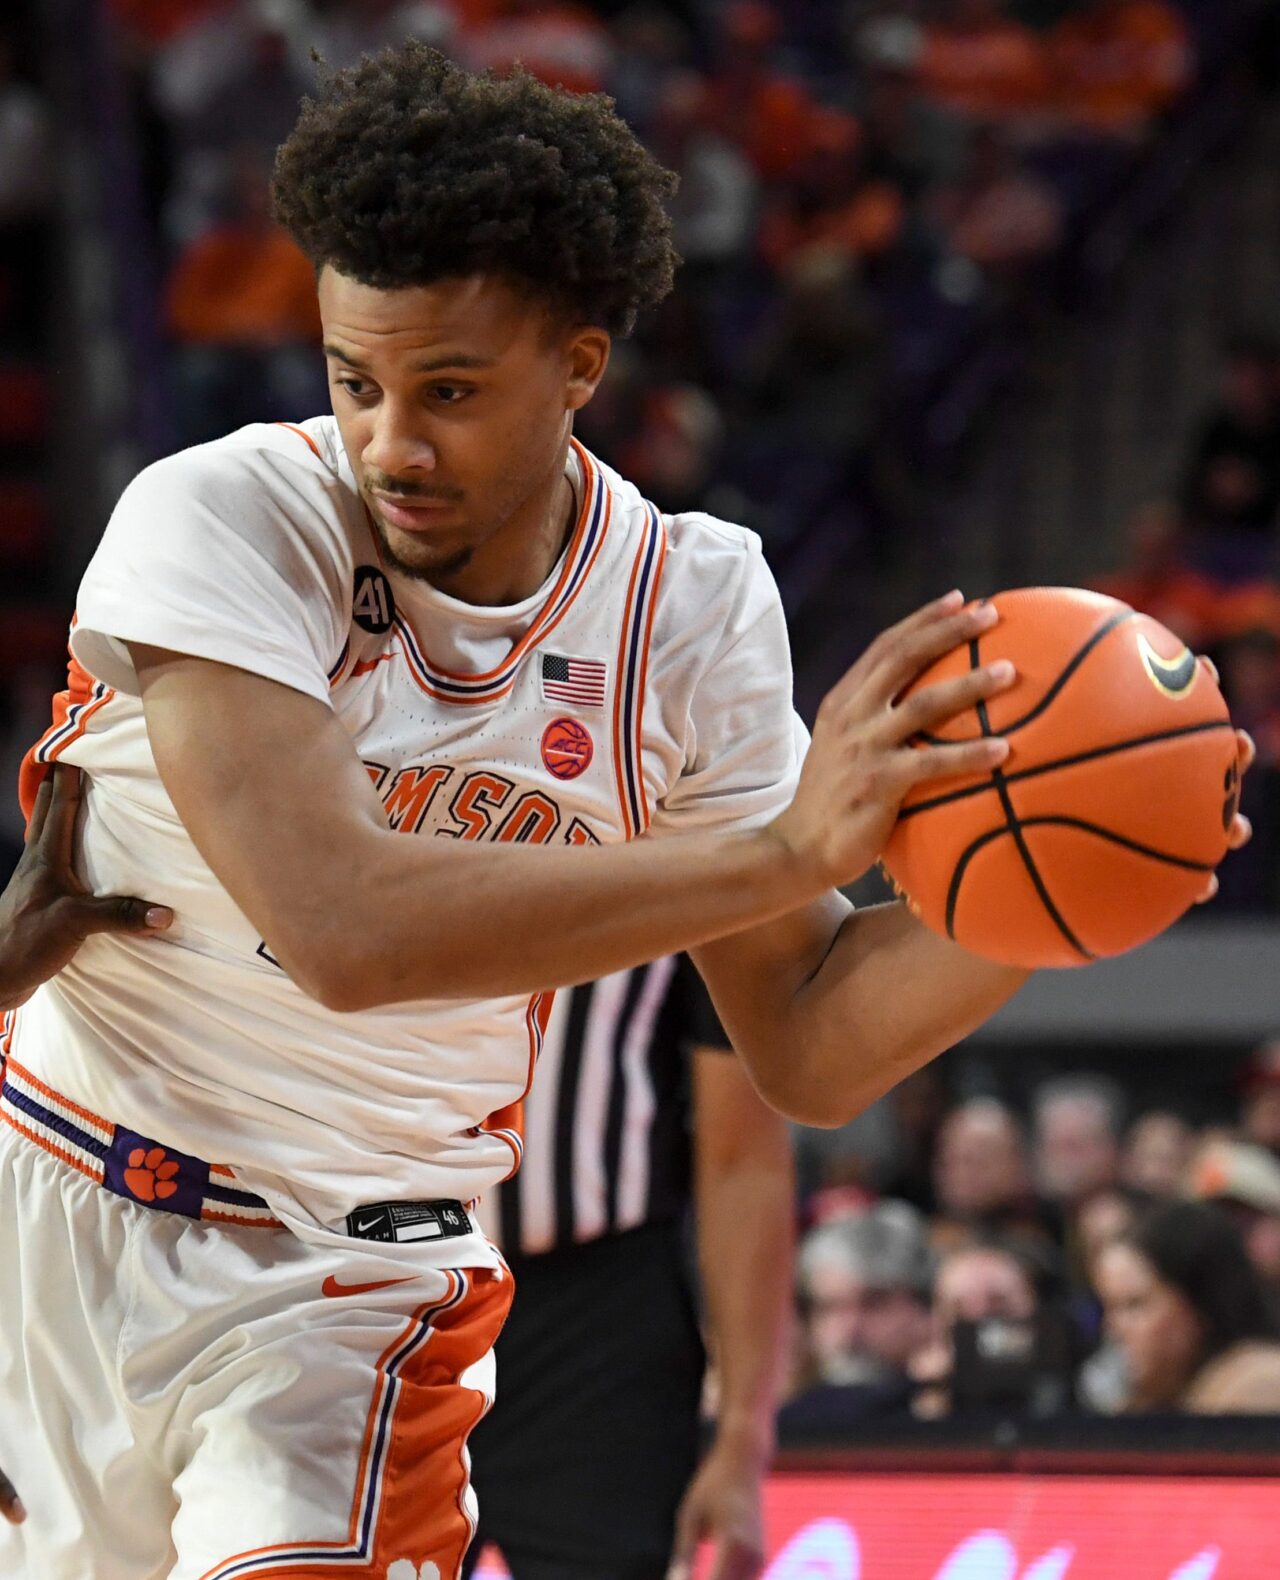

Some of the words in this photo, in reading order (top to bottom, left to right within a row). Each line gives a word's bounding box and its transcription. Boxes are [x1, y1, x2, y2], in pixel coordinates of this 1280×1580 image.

[352, 577, 390, 625] 41
[362, 760, 602, 846] MSO
[442, 1210, 459, 1225] 46
